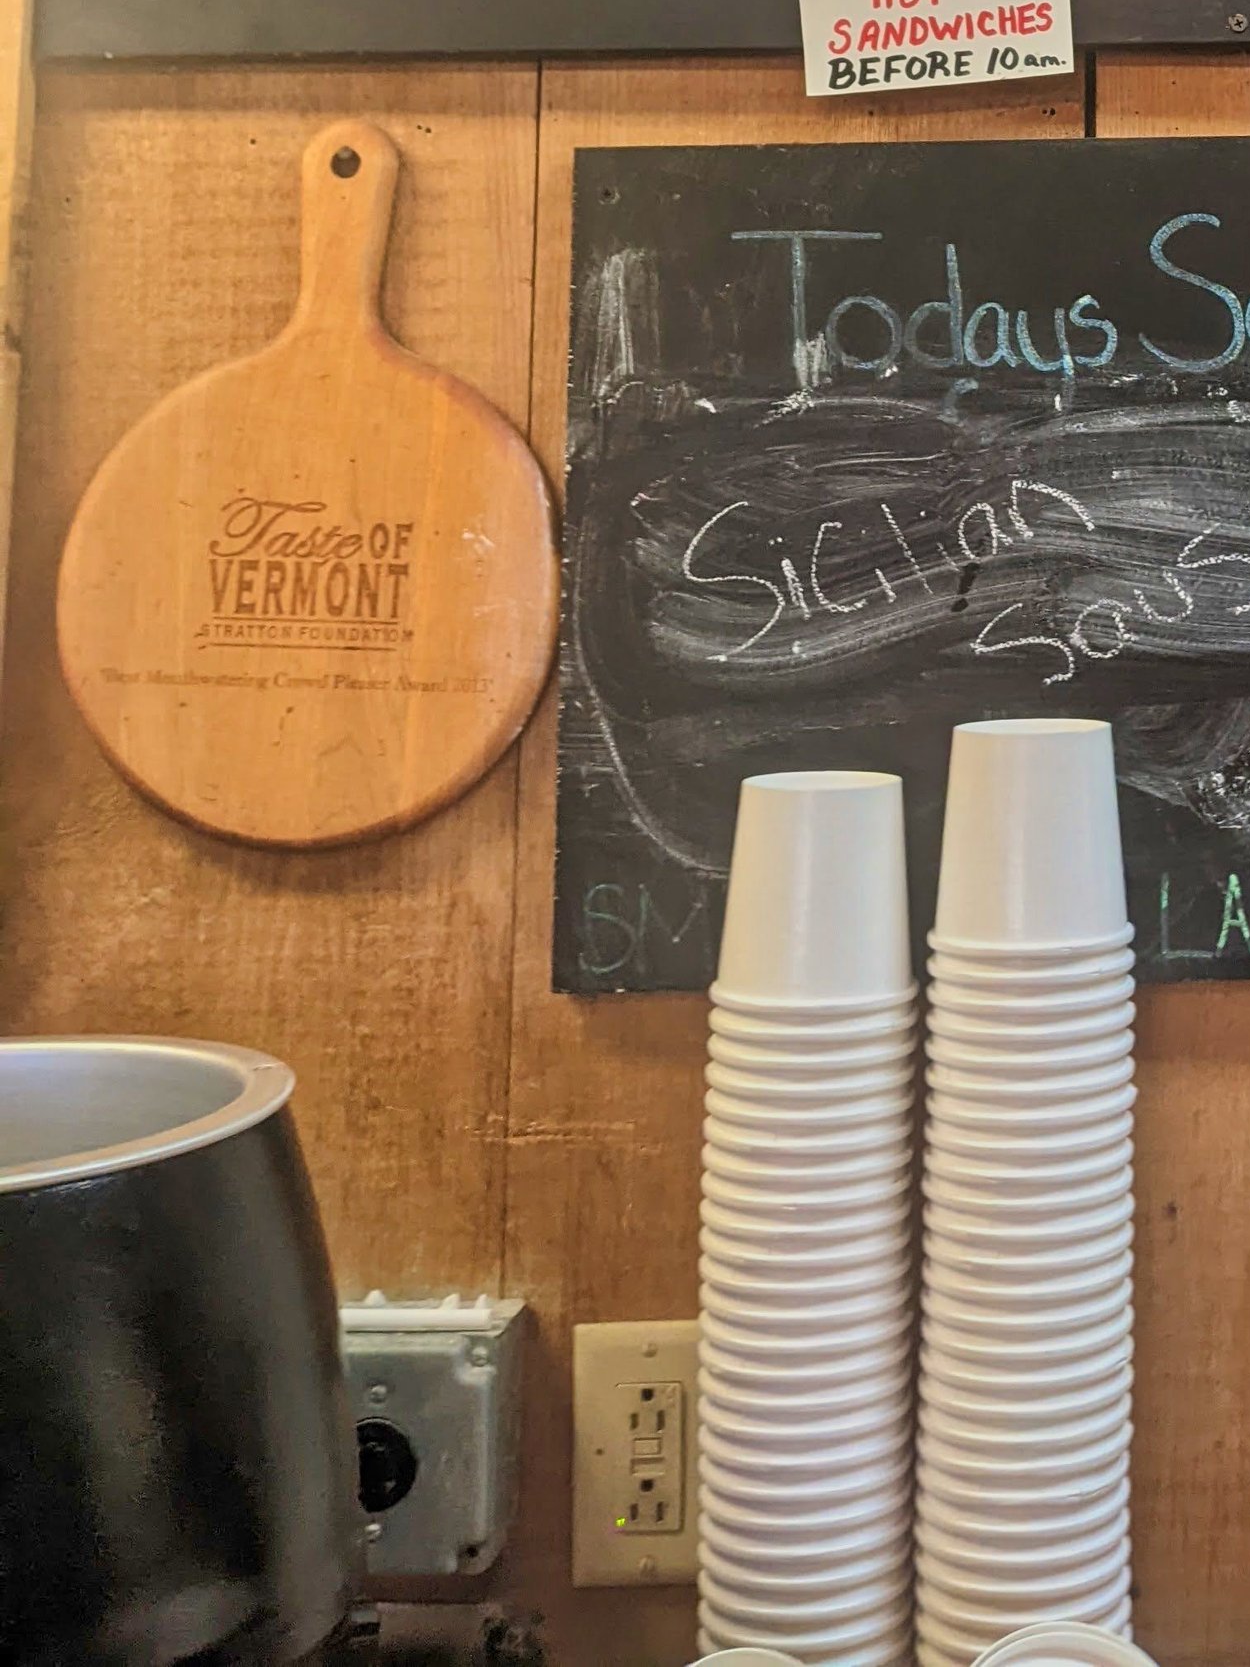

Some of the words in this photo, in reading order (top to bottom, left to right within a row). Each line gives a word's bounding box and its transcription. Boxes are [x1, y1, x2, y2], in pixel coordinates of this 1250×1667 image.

[828, 2, 1053, 55] SANDWICHES
[827, 50, 973, 90] BEFORE
[732, 230, 1117, 409] Todays
[209, 497, 363, 559] Taste
[370, 522, 414, 559] OF
[209, 559, 409, 618] VERMONT
